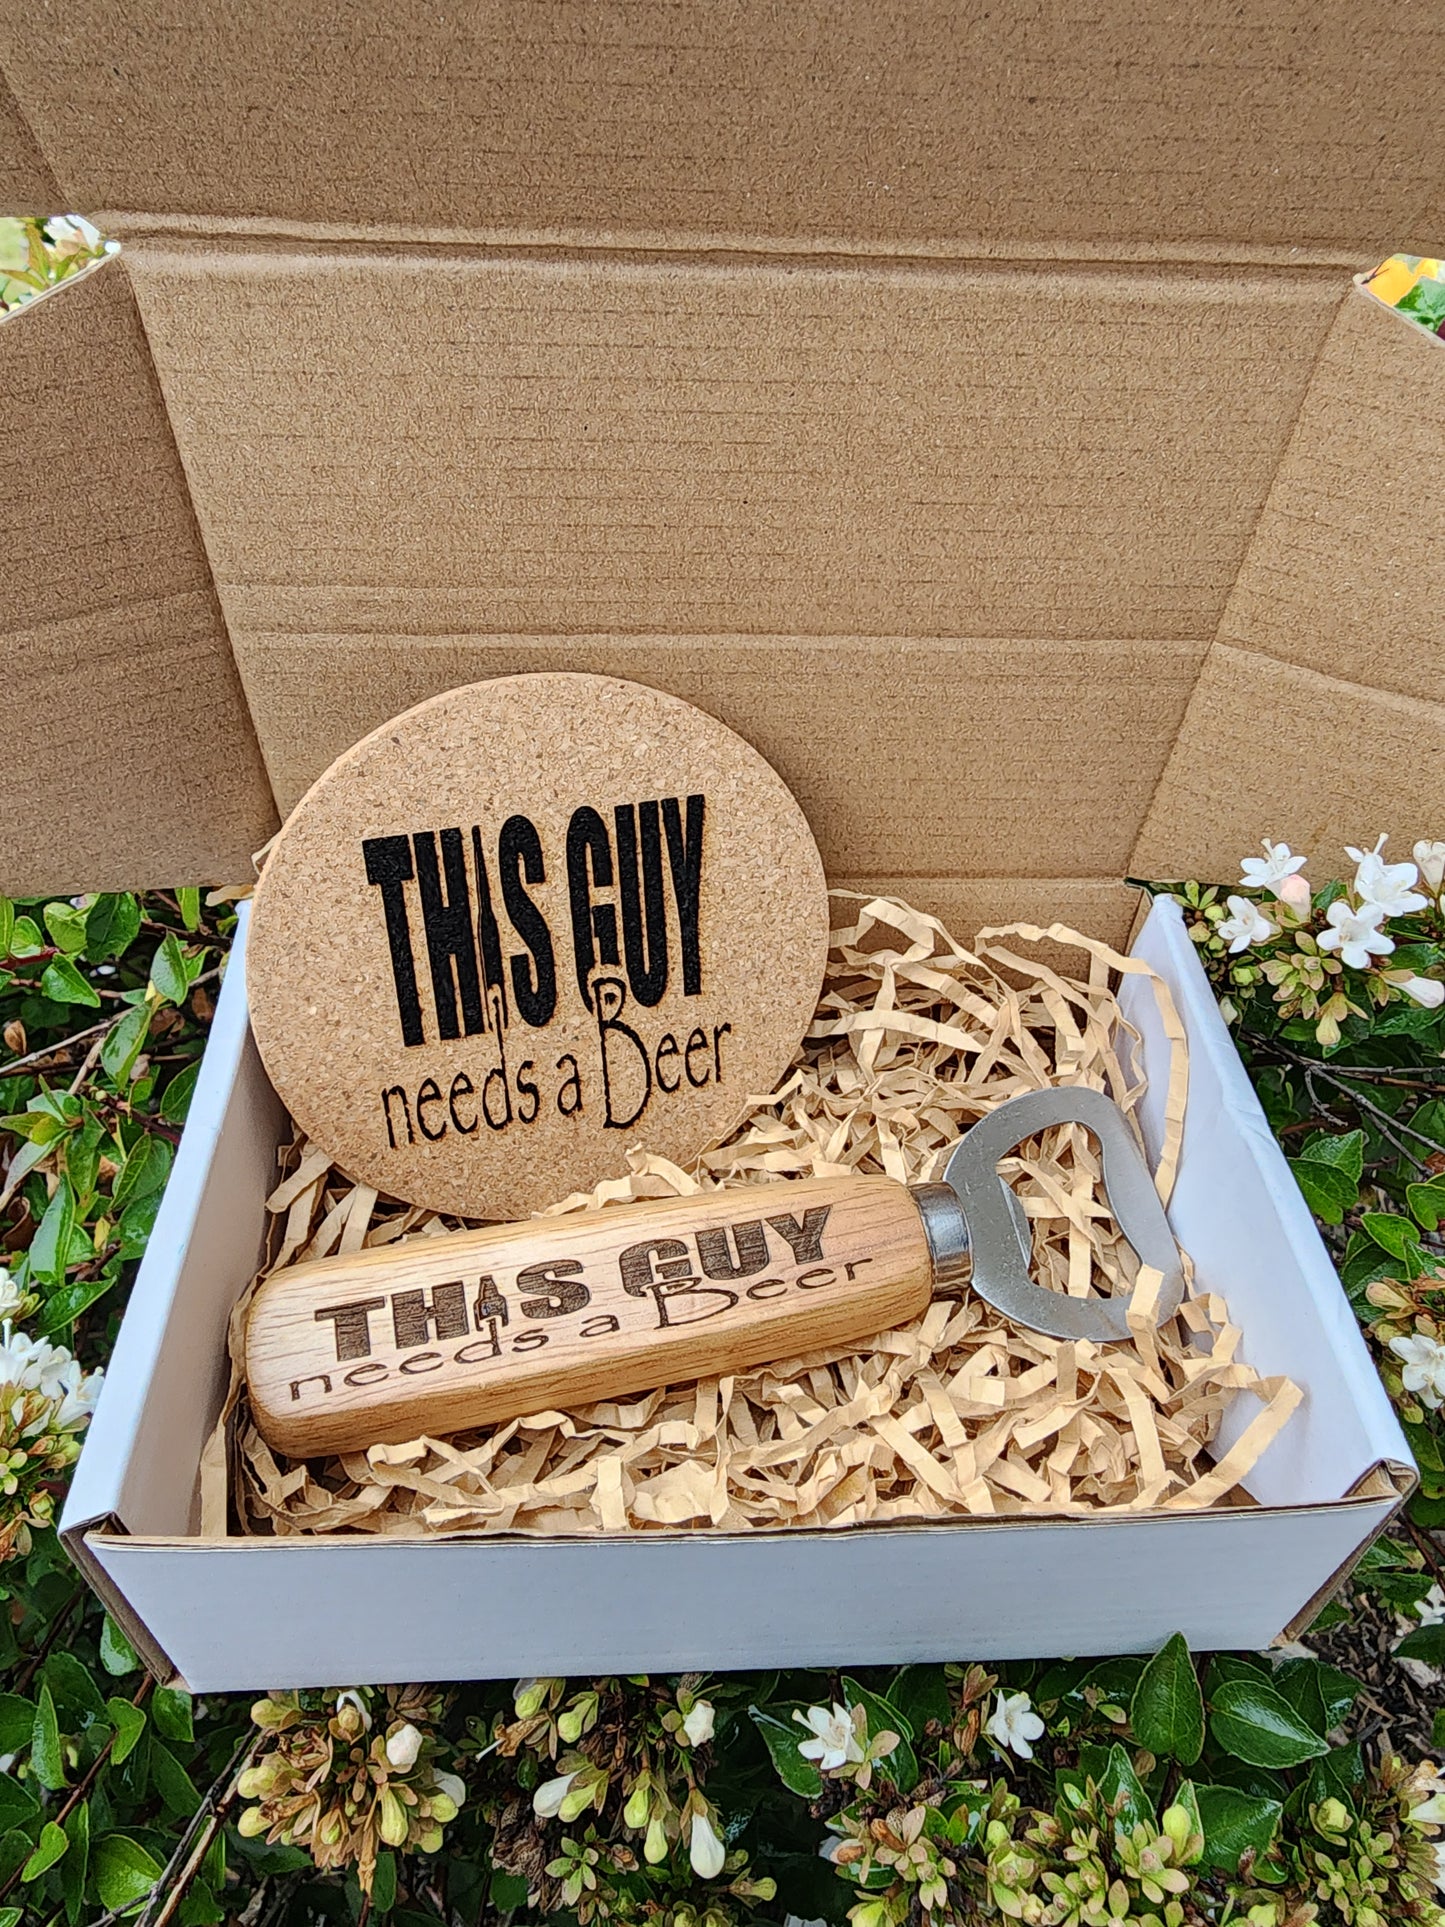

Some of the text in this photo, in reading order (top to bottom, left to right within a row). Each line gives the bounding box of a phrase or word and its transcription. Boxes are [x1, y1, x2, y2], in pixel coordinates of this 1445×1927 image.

[362, 794, 705, 1048] THIS GUY
[381, 976, 732, 1149] needs a Beer
[289, 1258, 873, 1401] needs a Beer
[314, 1205, 831, 1362] THIS GUY
